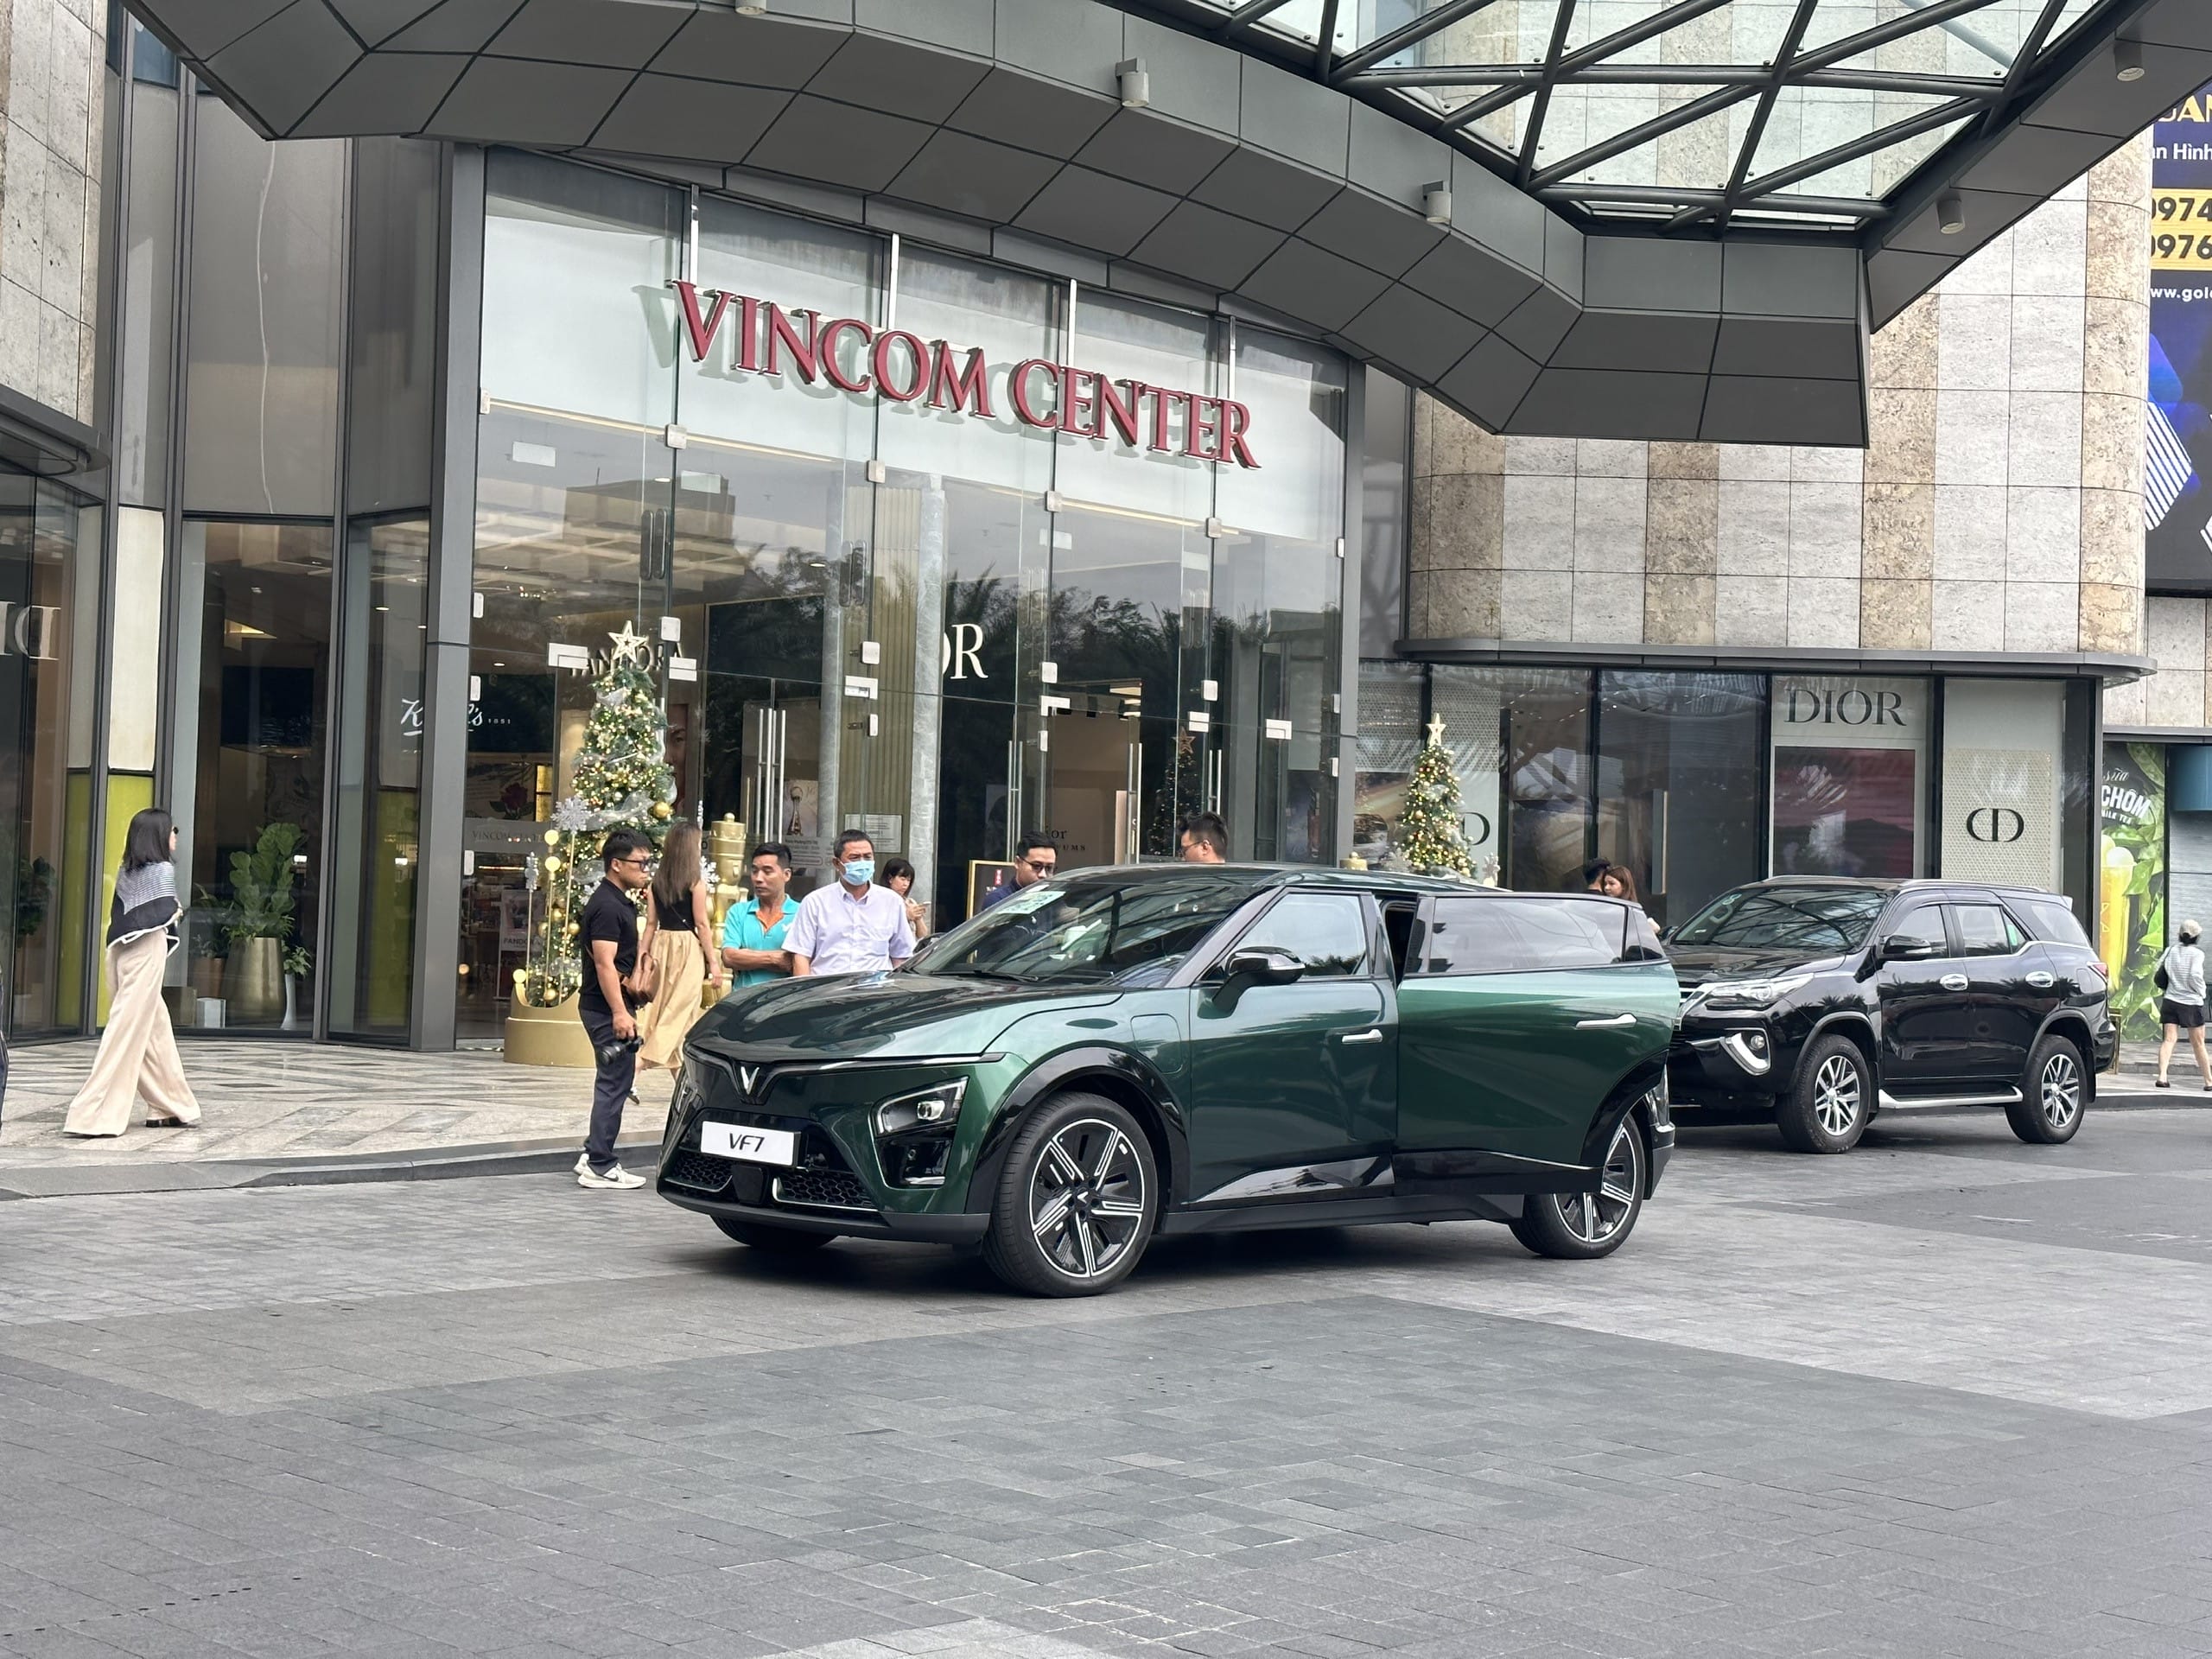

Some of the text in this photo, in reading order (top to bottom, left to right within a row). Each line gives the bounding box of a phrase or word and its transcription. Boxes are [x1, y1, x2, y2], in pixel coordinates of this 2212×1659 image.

[2150, 287, 2212, 302] ww.gol
[666, 280, 1262, 469] VINCOM CENTER
[1783, 690, 1907, 727] DIOR
[2101, 785, 2152, 818] CHÔM
[729, 1132, 765, 1153] VF7
